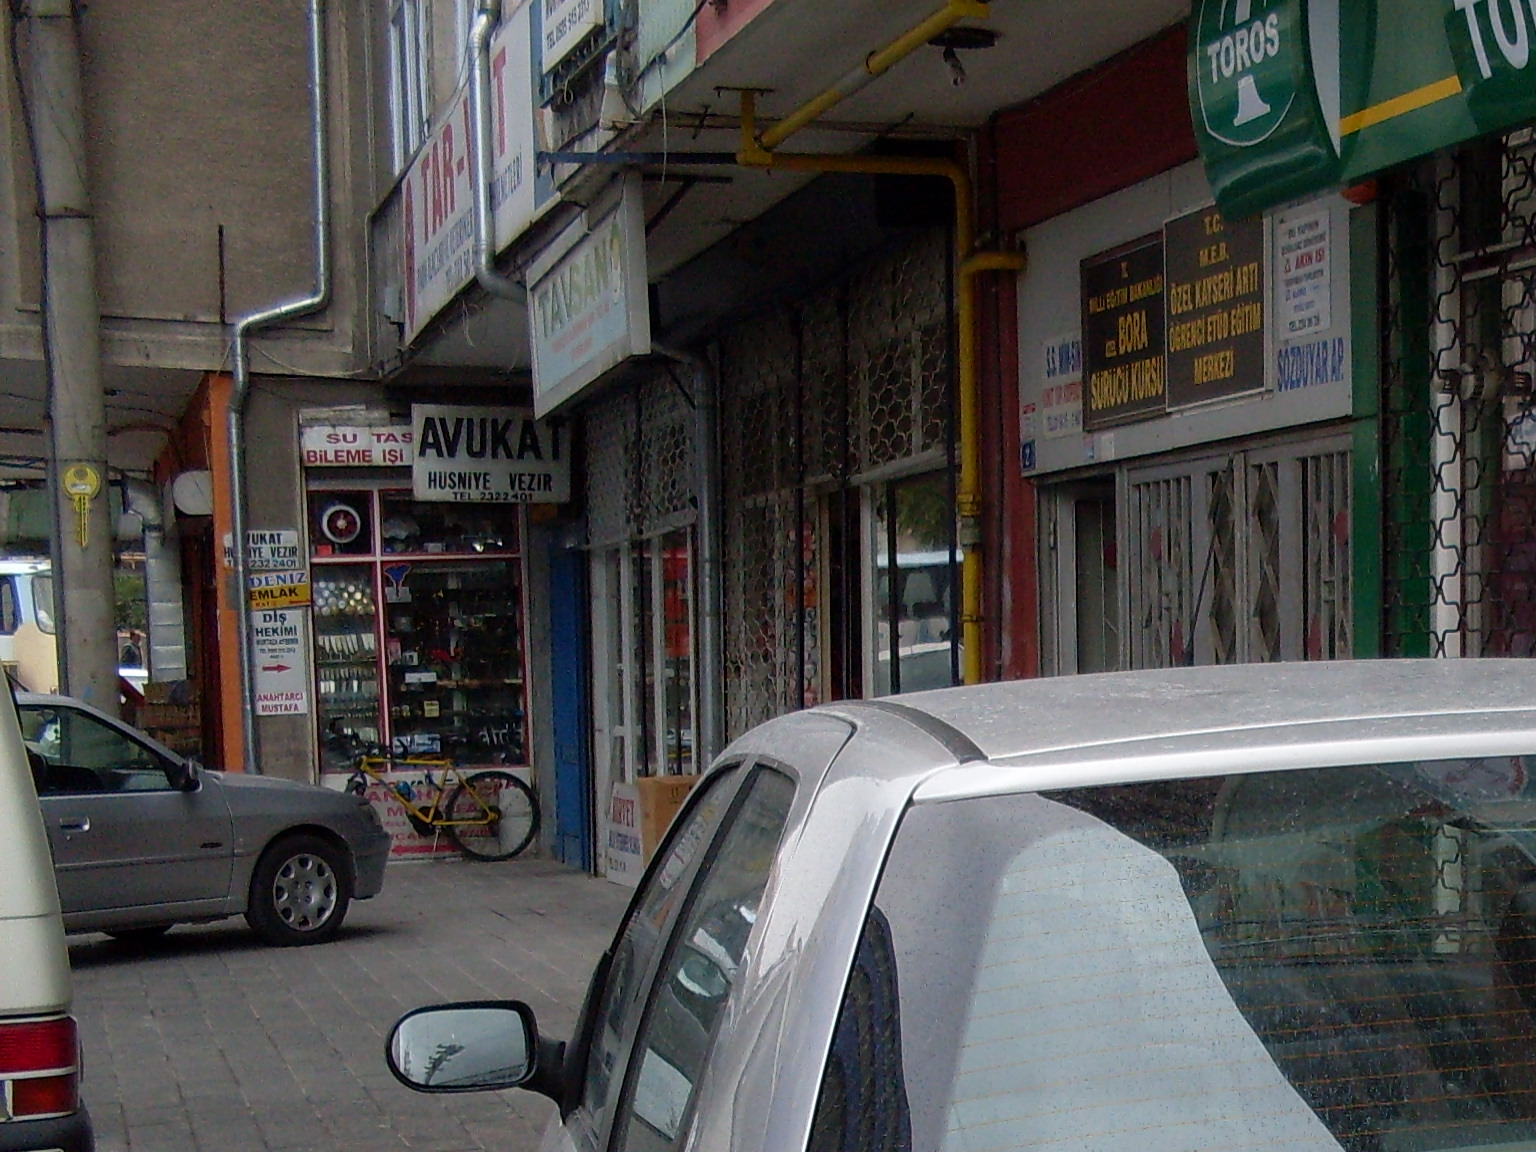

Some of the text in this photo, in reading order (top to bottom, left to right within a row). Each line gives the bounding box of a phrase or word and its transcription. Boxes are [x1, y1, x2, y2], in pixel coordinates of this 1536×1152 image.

[1207, 13, 1280, 84] TOROS
[1118, 309, 1148, 355] BORA
[1131, 355, 1165, 401] KURSU
[326, 433, 358, 444] SU
[418, 416, 566, 461] AVUKAT
[250, 588, 299, 601] EMLAK
[263, 609, 287, 625] DİŞ
[256, 625, 298, 637] HEKİMİ
[257, 692, 304, 702] ANAHTARCI
[261, 703, 301, 713] MUSTAFA
